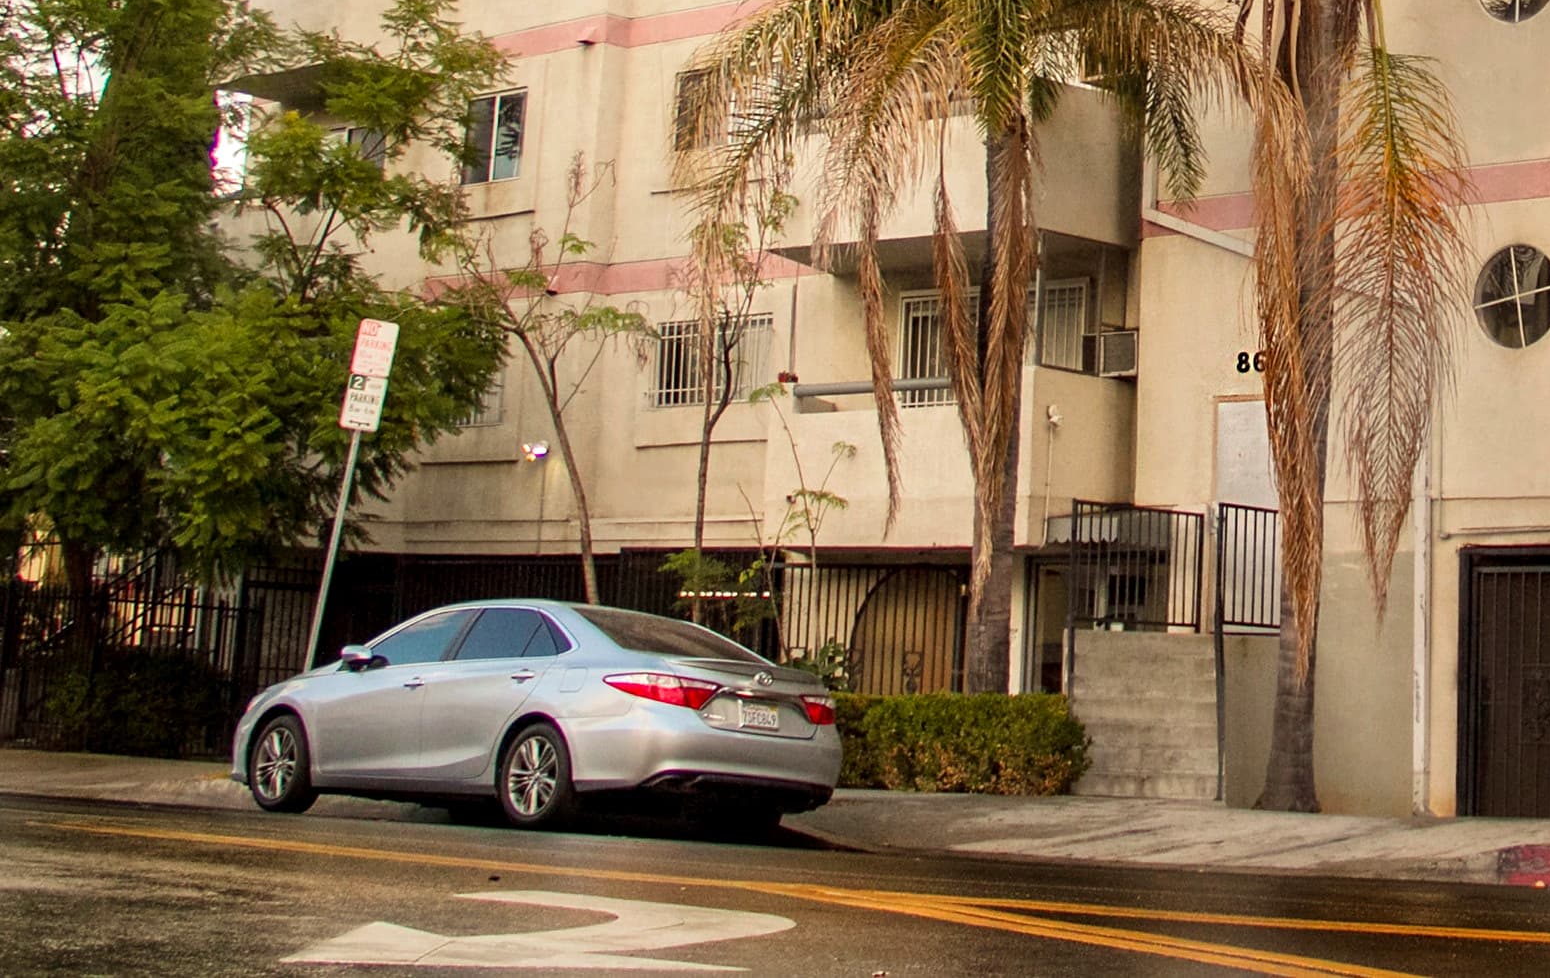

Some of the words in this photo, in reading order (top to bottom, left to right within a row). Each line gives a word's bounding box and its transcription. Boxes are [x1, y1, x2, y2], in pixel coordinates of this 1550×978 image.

[362, 321, 377, 335] NO
[360, 337, 392, 352] PARKING
[353, 376, 364, 389] 2
[350, 391, 380, 406] PARKING
